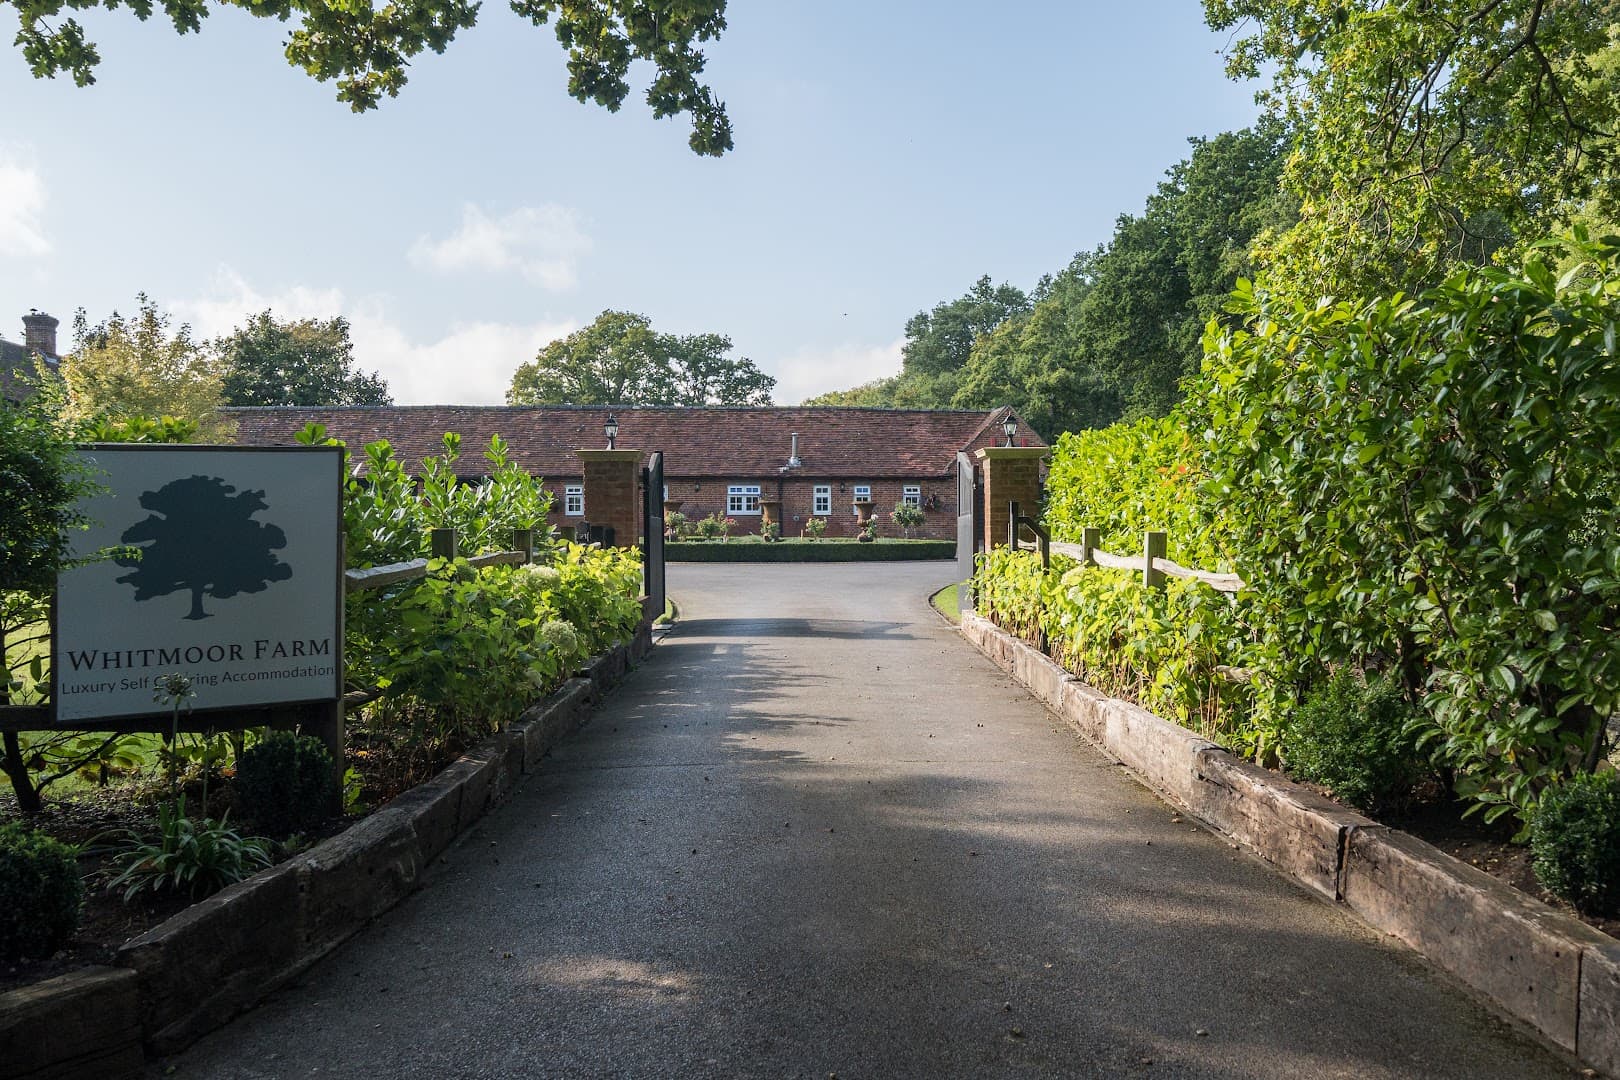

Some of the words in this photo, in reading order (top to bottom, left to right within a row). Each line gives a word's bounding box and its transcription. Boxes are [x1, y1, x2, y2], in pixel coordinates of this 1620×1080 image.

[67, 644, 244, 671] WHITMOOR
[254, 638, 330, 659] FARM
[62, 681, 117, 695] Luxury
[120, 677, 149, 690] Self
[153, 671, 217, 688] Cring
[222, 664, 335, 683] Accommodation
